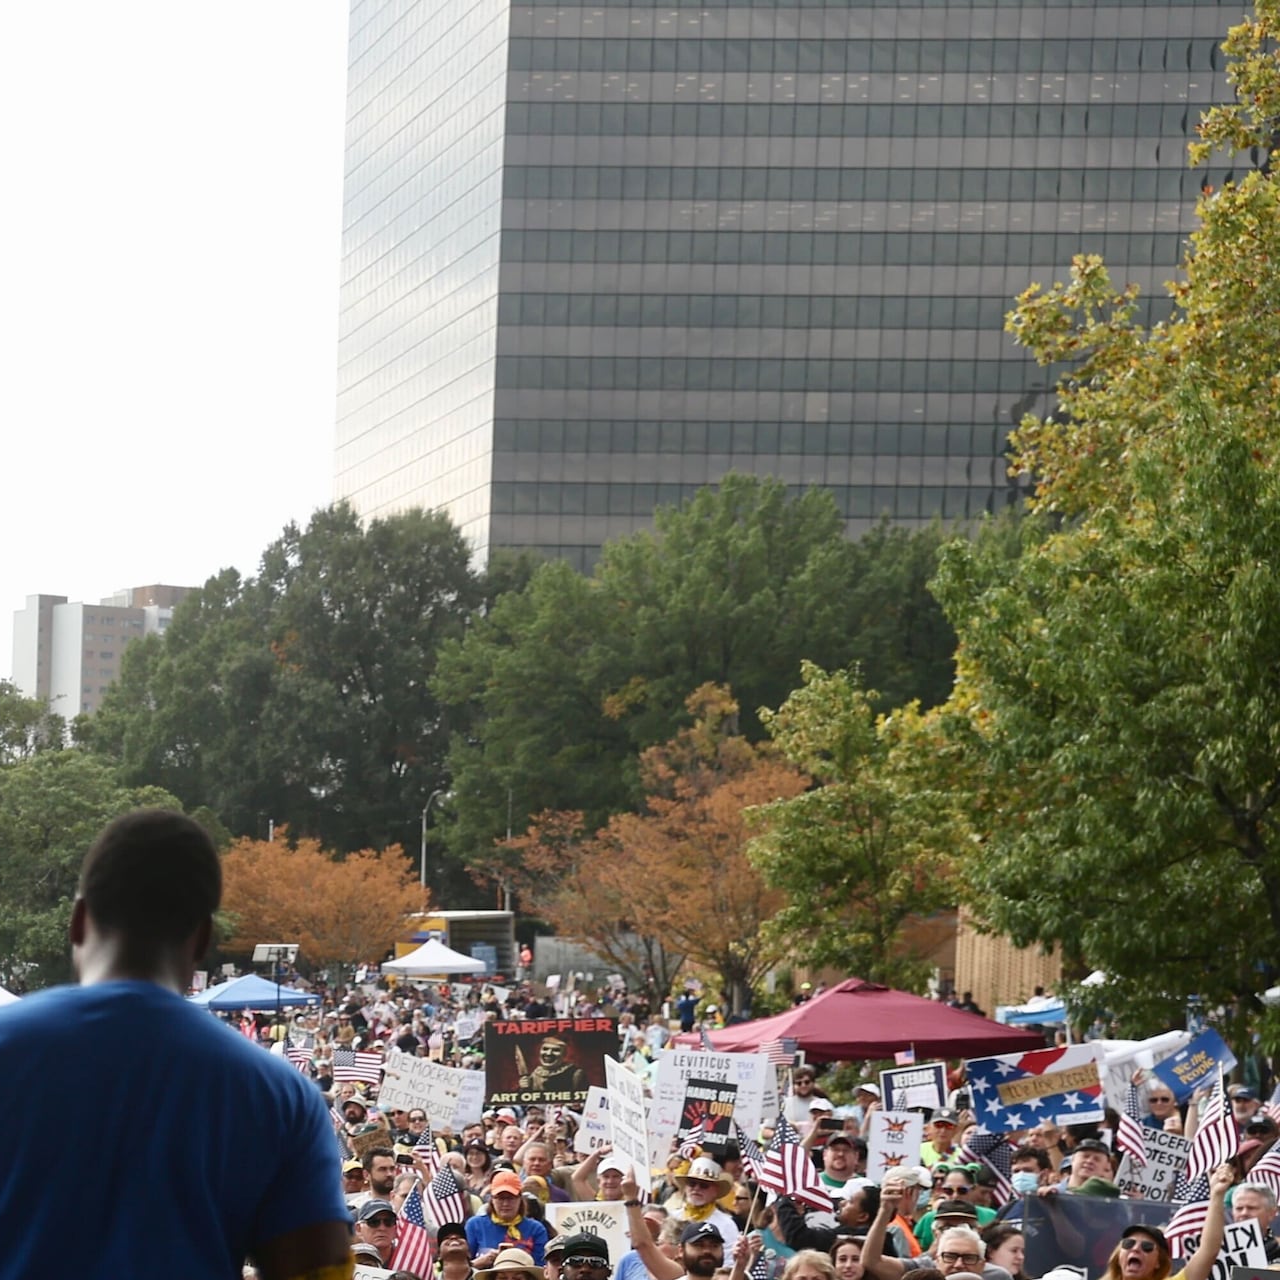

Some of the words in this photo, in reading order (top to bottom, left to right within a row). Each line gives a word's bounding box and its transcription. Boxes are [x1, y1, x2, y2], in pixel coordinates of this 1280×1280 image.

[493, 1019, 613, 1035] TARIFFIER
[673, 1054, 731, 1070] LEVITICUS
[1172, 1063, 1192, 1078] We
[1189, 1050, 1207, 1066] the
[391, 1054, 466, 1088] DEMOCRACY
[892, 1070, 935, 1086] VETERANS
[1178, 1058, 1216, 1085] People
[409, 1078, 434, 1093] NOT
[380, 1084, 457, 1119] DICTATORSHIP
[491, 1093, 516, 1102] ART
[521, 1092, 540, 1101] OF
[544, 1092, 570, 1101] THE
[688, 1086, 717, 1100] HANDS
[719, 1090, 737, 1103] OFF
[710, 1103, 733, 1116] OUR
[887, 1132, 904, 1140] NO
[1153, 1169, 1165, 1182] IS
[561, 1217, 576, 1231] NO
[575, 1210, 617, 1229] TYRANTS
